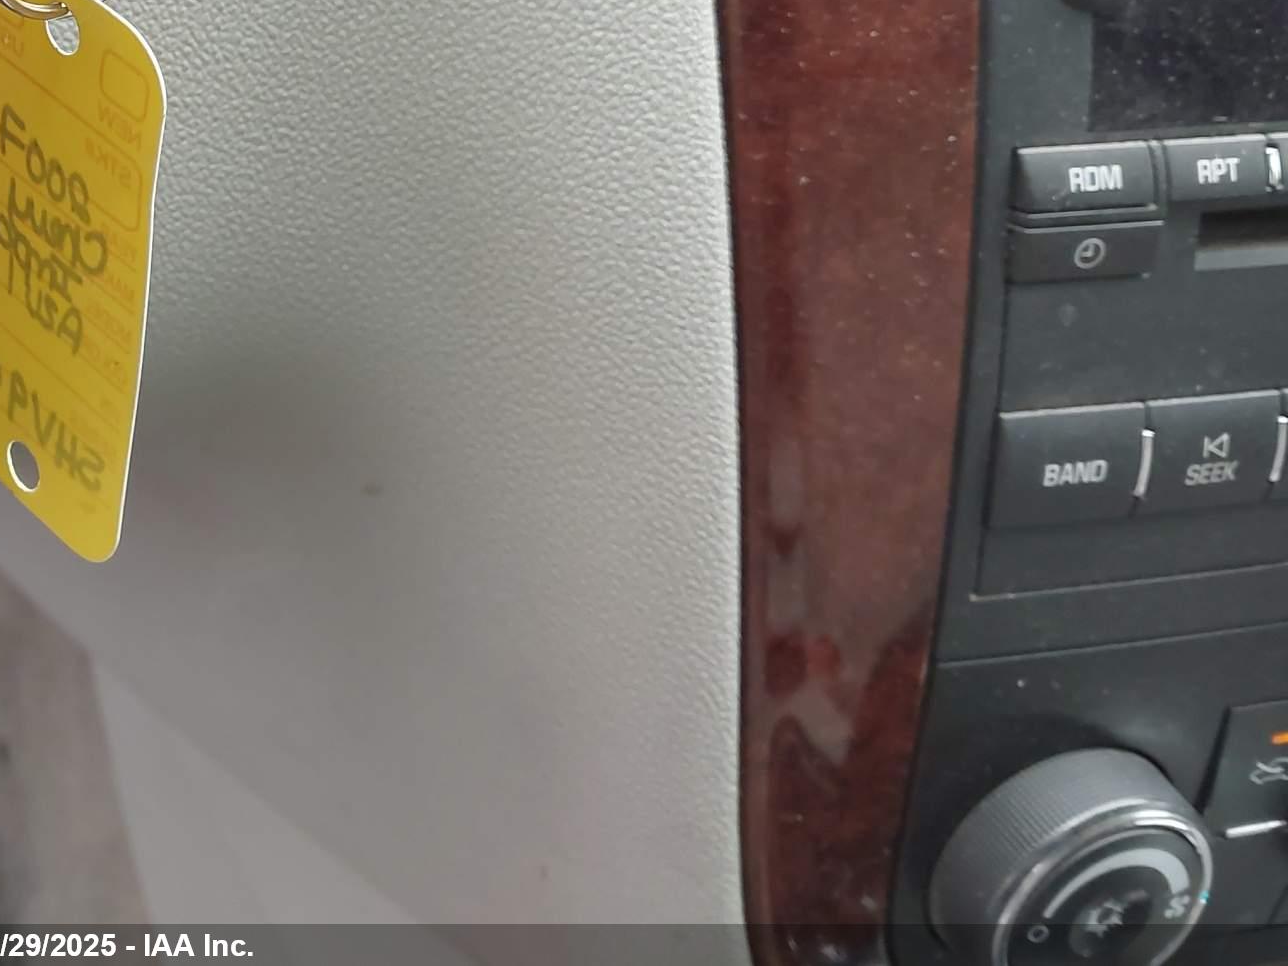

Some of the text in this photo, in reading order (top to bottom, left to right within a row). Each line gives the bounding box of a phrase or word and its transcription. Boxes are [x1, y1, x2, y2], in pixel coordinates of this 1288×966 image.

[1069, 164, 1123, 193] RDM
[1197, 157, 1240, 184] RPT
[1043, 460, 1108, 487] BAND
[1184, 460, 1238, 486] SEEK
